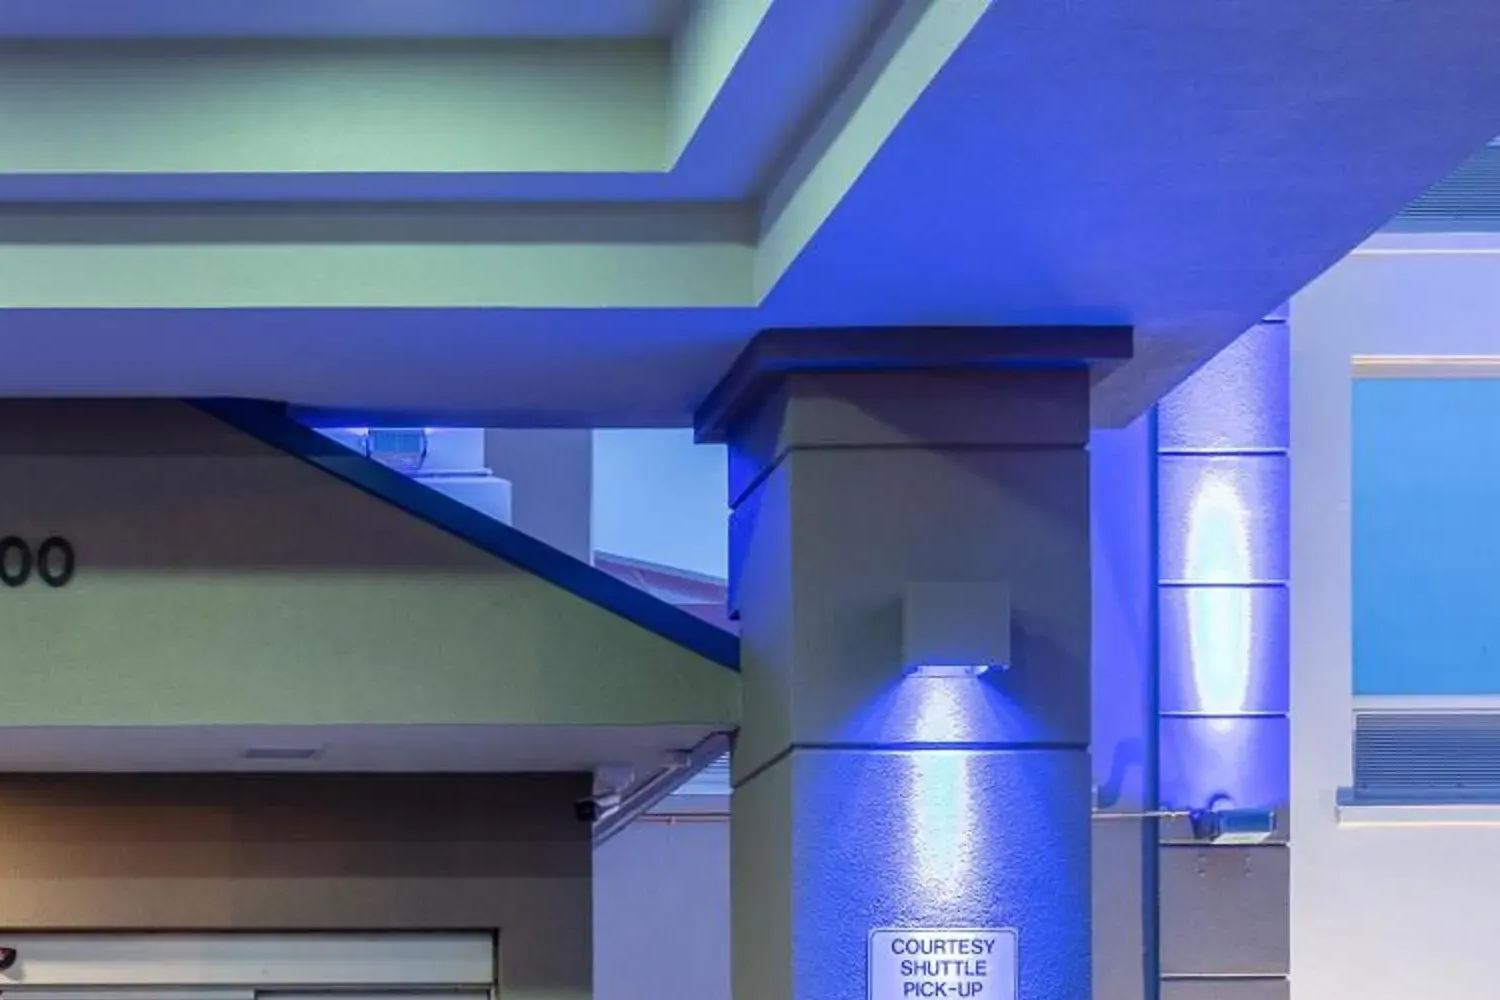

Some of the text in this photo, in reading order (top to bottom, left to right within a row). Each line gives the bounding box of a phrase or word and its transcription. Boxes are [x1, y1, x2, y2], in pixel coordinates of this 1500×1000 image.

[891, 938, 996, 955] COURTESY
[901, 960, 987, 976] SHUTTLE
[903, 981, 983, 997] PICK-UP
